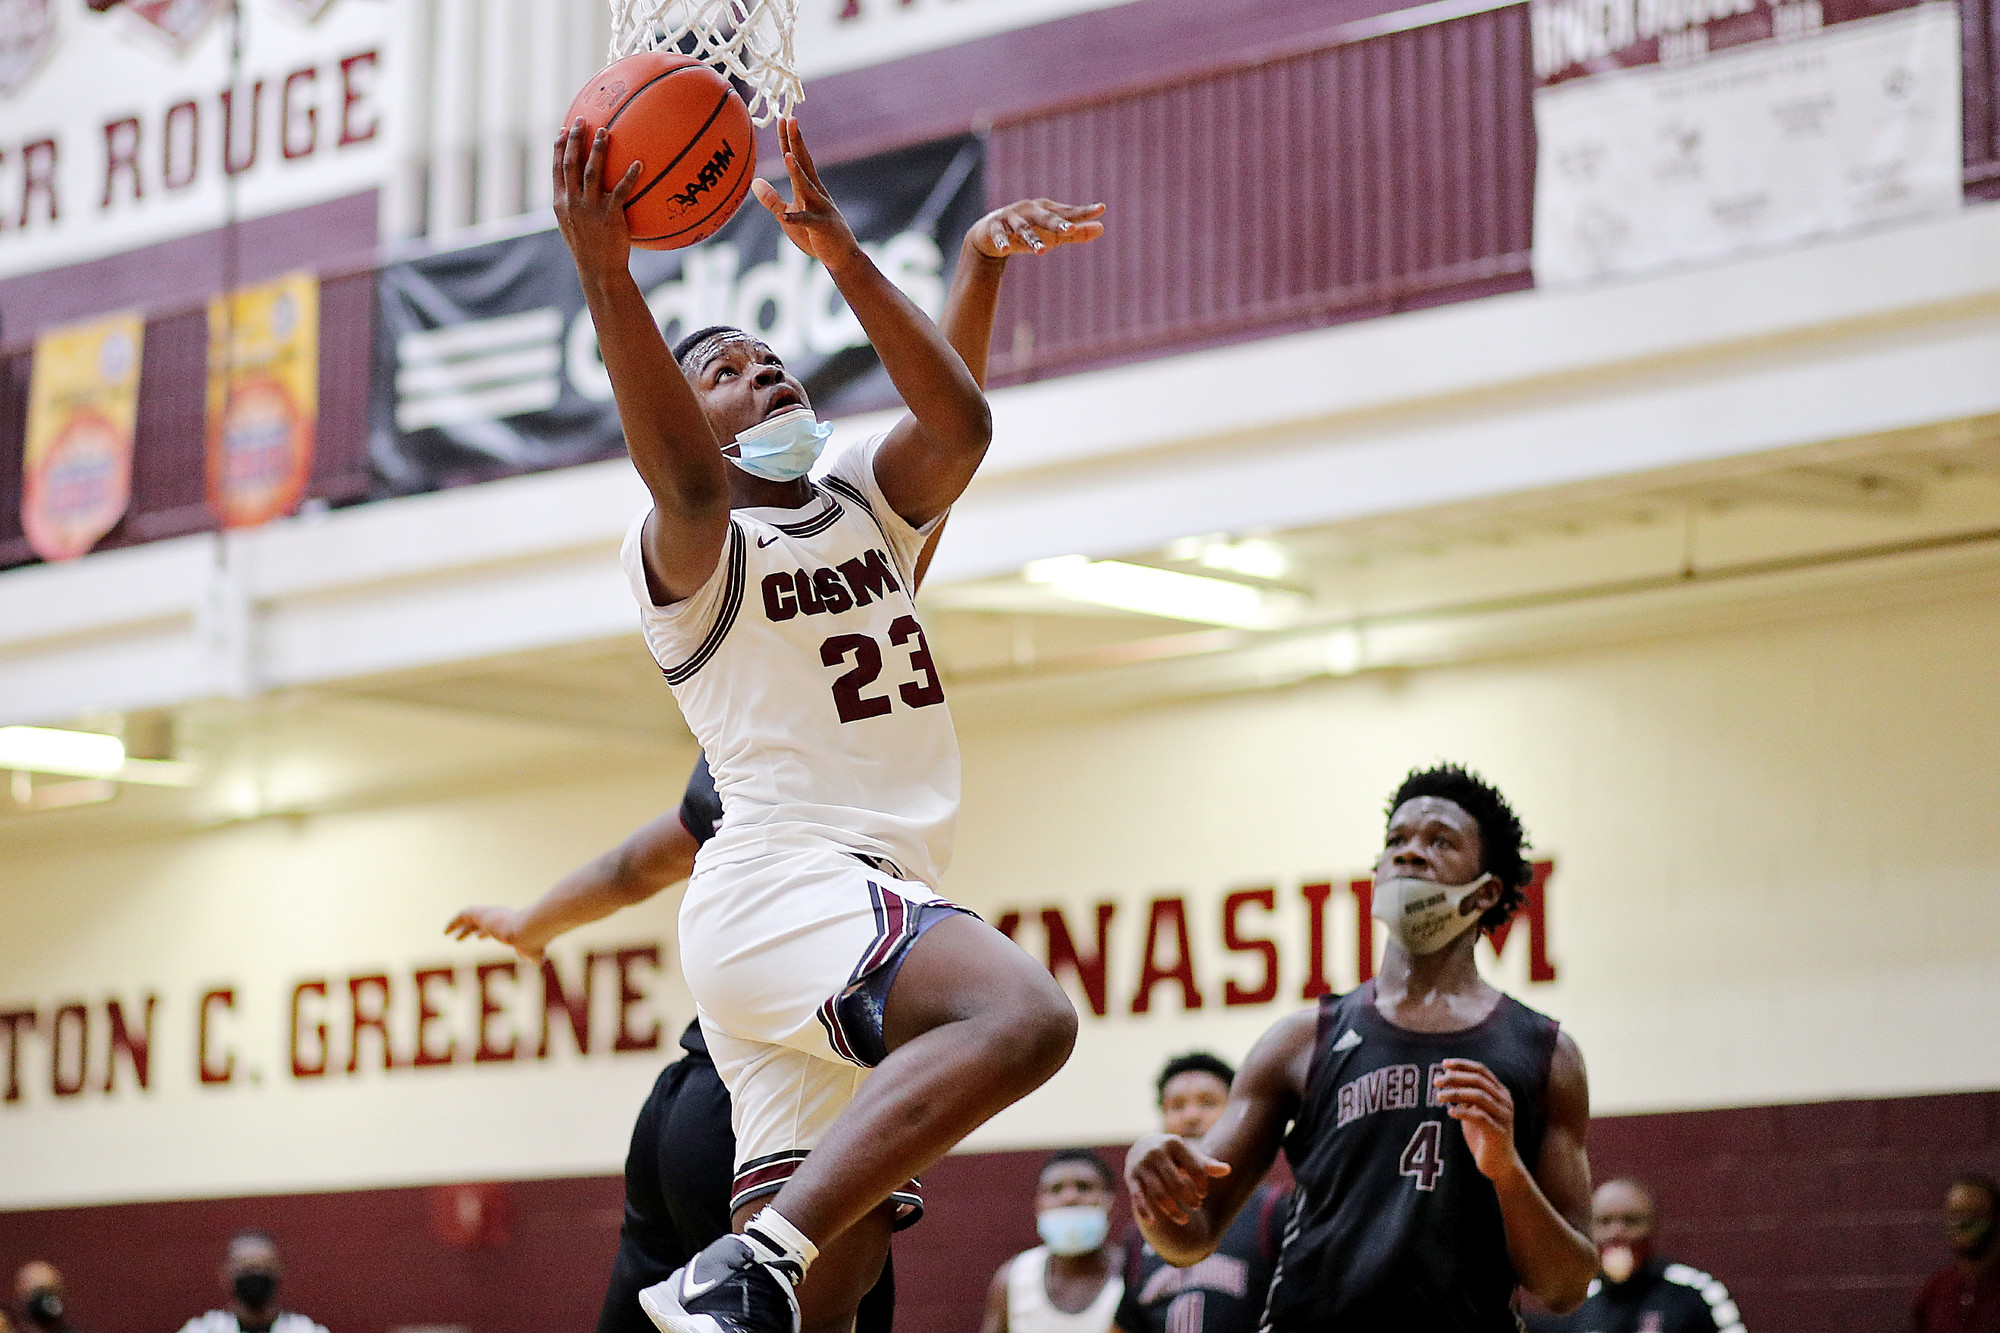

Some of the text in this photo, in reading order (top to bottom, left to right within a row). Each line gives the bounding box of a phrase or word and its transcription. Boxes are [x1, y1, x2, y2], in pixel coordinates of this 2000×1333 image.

[100, 50, 378, 208] ROUGE
[761, 548, 902, 623] COSM
[819, 614, 945, 724] 23
[0, 994, 156, 1103] TON
[291, 946, 662, 1079] GREENE
[997, 860, 1558, 1018] NASIM
[1336, 1063, 1421, 1130] RIVER
[1400, 1120, 1445, 1192] 4
